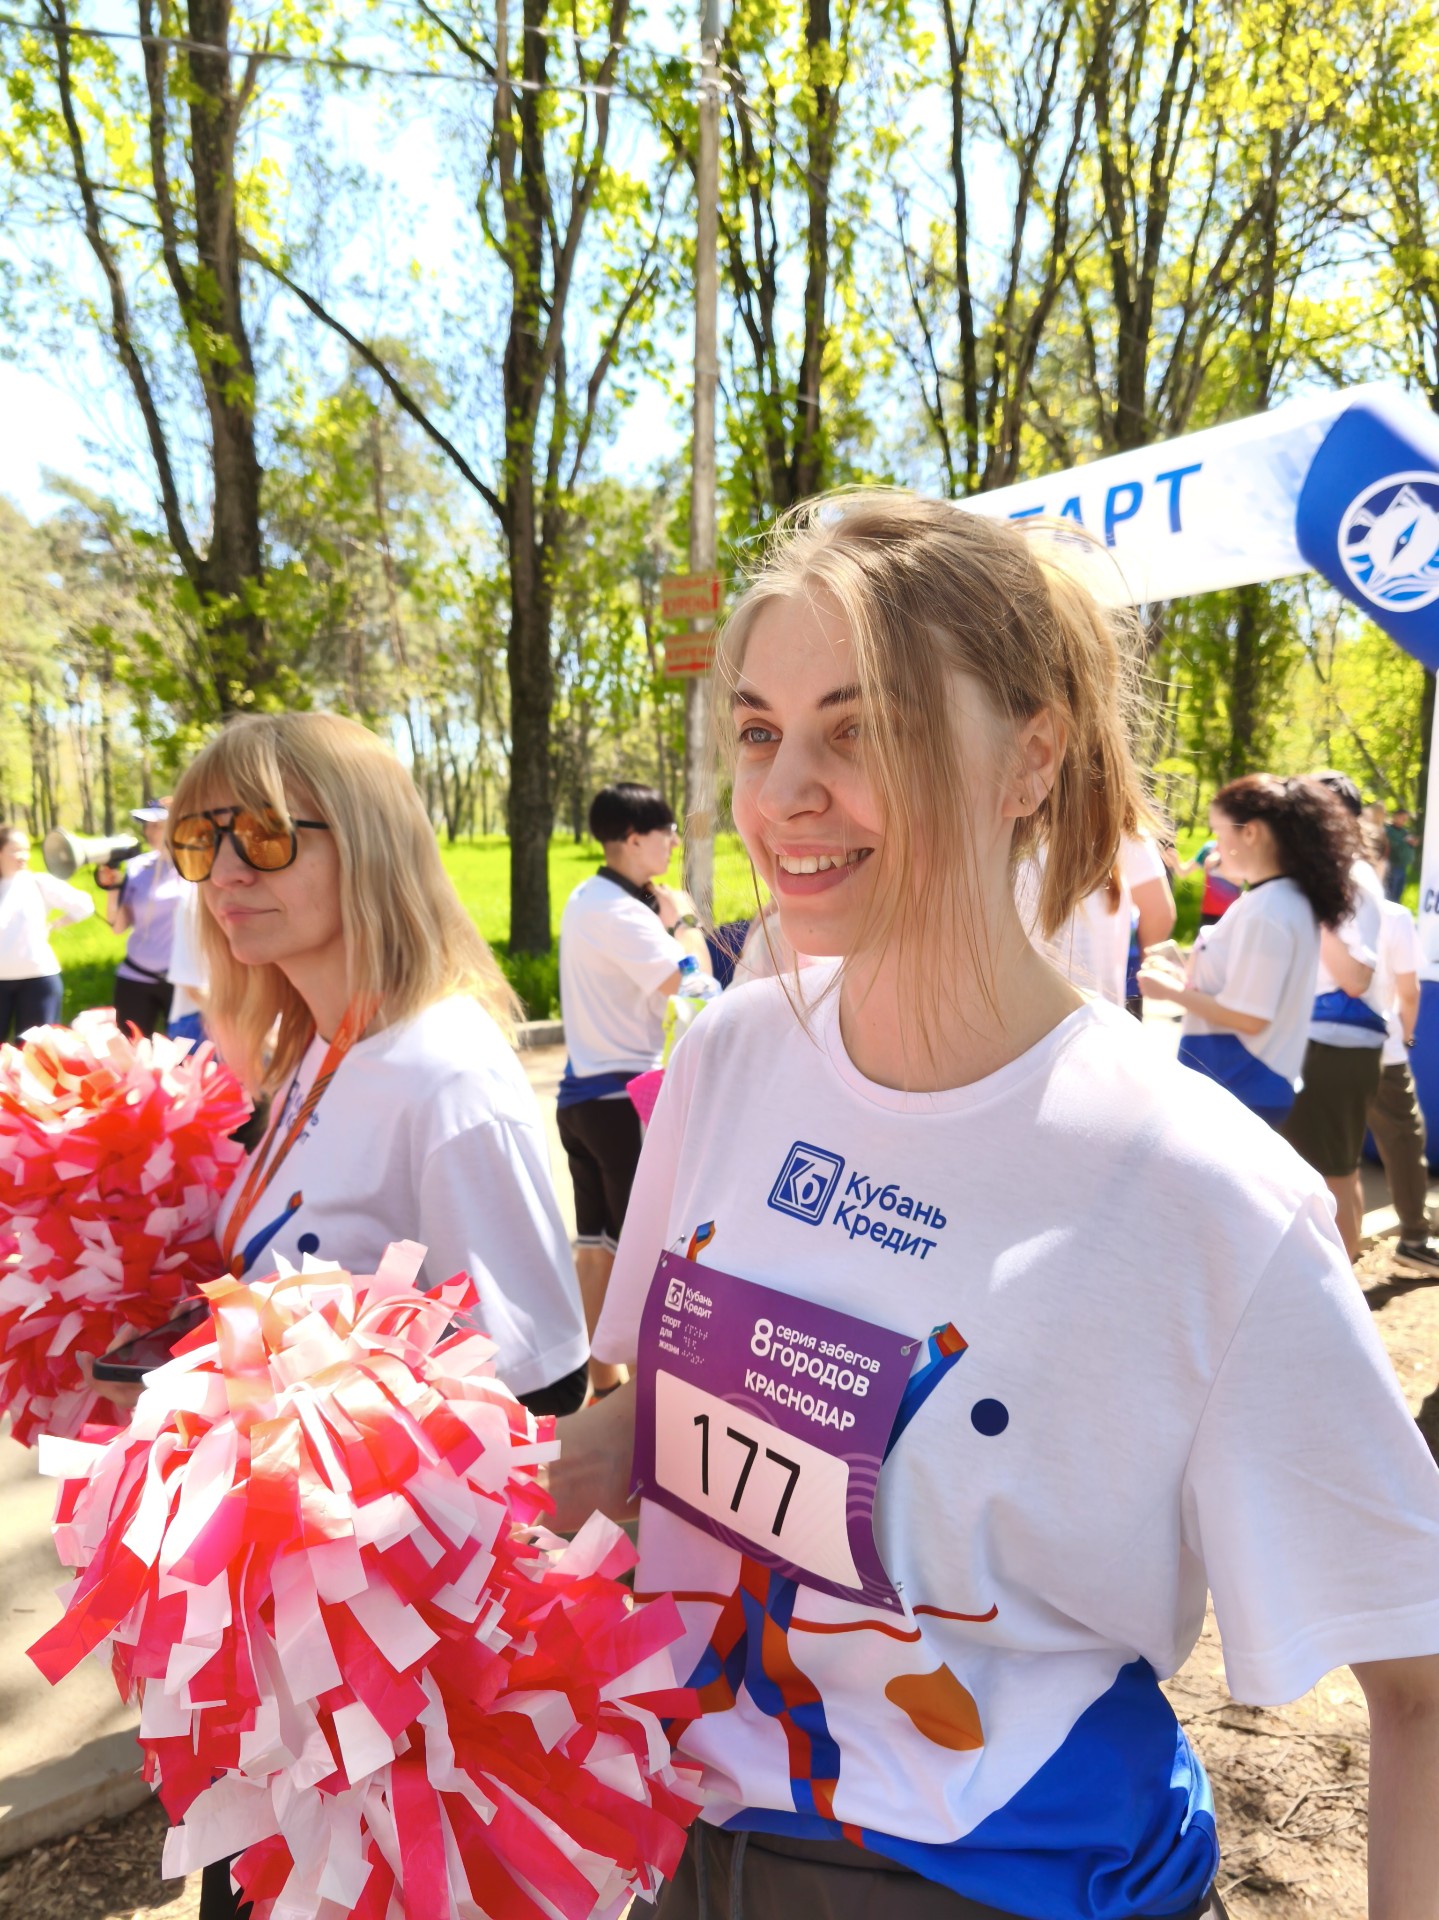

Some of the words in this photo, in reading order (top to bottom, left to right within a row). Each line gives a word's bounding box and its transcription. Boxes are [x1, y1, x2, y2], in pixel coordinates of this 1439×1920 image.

[1009, 462, 1203, 553] АРТ
[845, 1171, 947, 1230] Кубань
[832, 1200, 938, 1260] Кредит
[683, 1298, 712, 1319] Кредит
[685, 1287, 713, 1307] Кубань
[659, 1326, 673, 1339] для
[661, 1313, 681, 1328] спорт
[750, 1318, 774, 1357] 8
[658, 1339, 680, 1356] жизни
[776, 1325, 817, 1350] серия
[818, 1340, 881, 1374] забегов
[744, 1368, 856, 1432] КРАСНОДАР
[693, 1413, 801, 1537] 177
